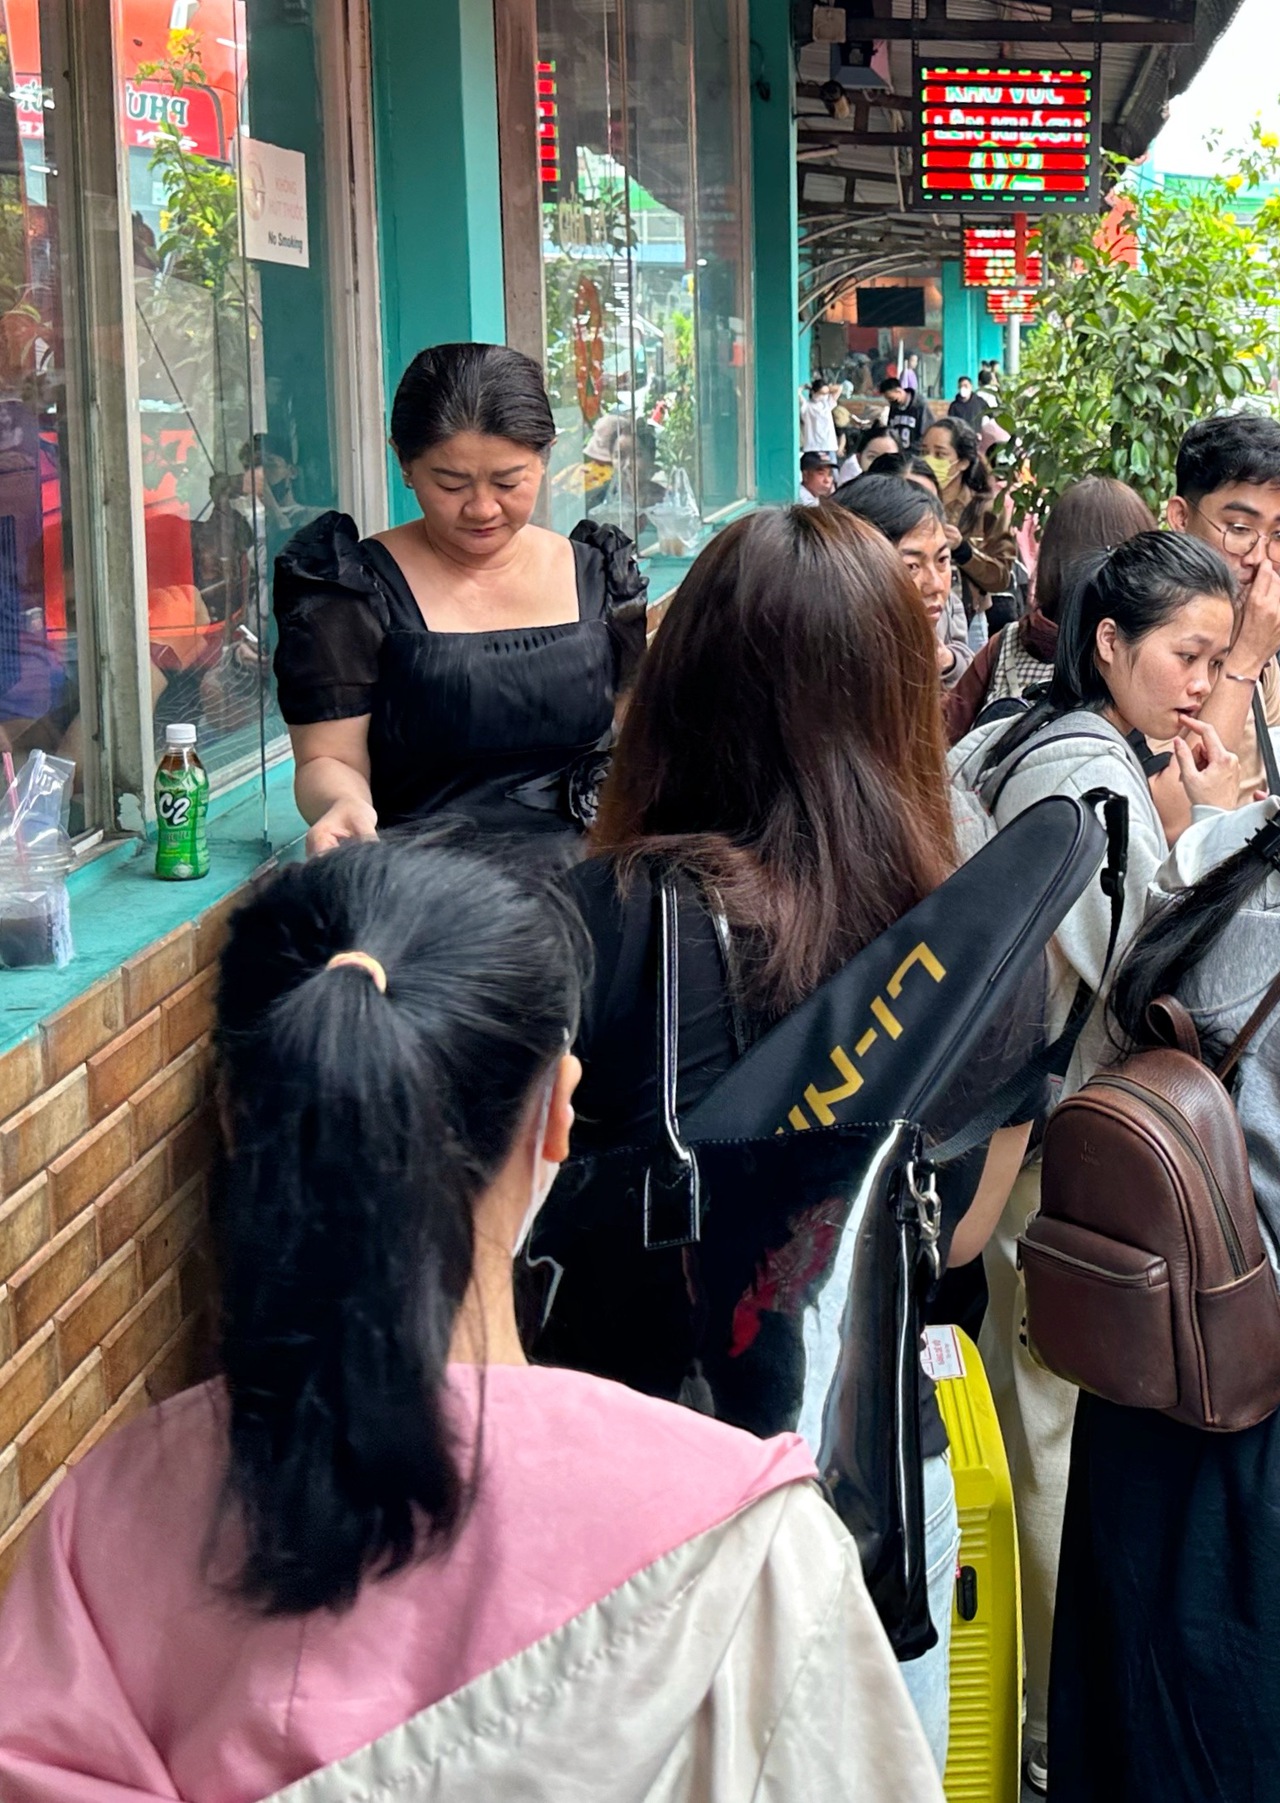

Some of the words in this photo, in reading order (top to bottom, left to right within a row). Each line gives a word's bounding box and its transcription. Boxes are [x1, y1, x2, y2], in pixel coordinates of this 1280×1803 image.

[267, 230, 278, 246] No
[278, 232, 304, 255] Smoking
[159, 792, 191, 826] C2
[775, 941, 947, 1136] LI-NI
